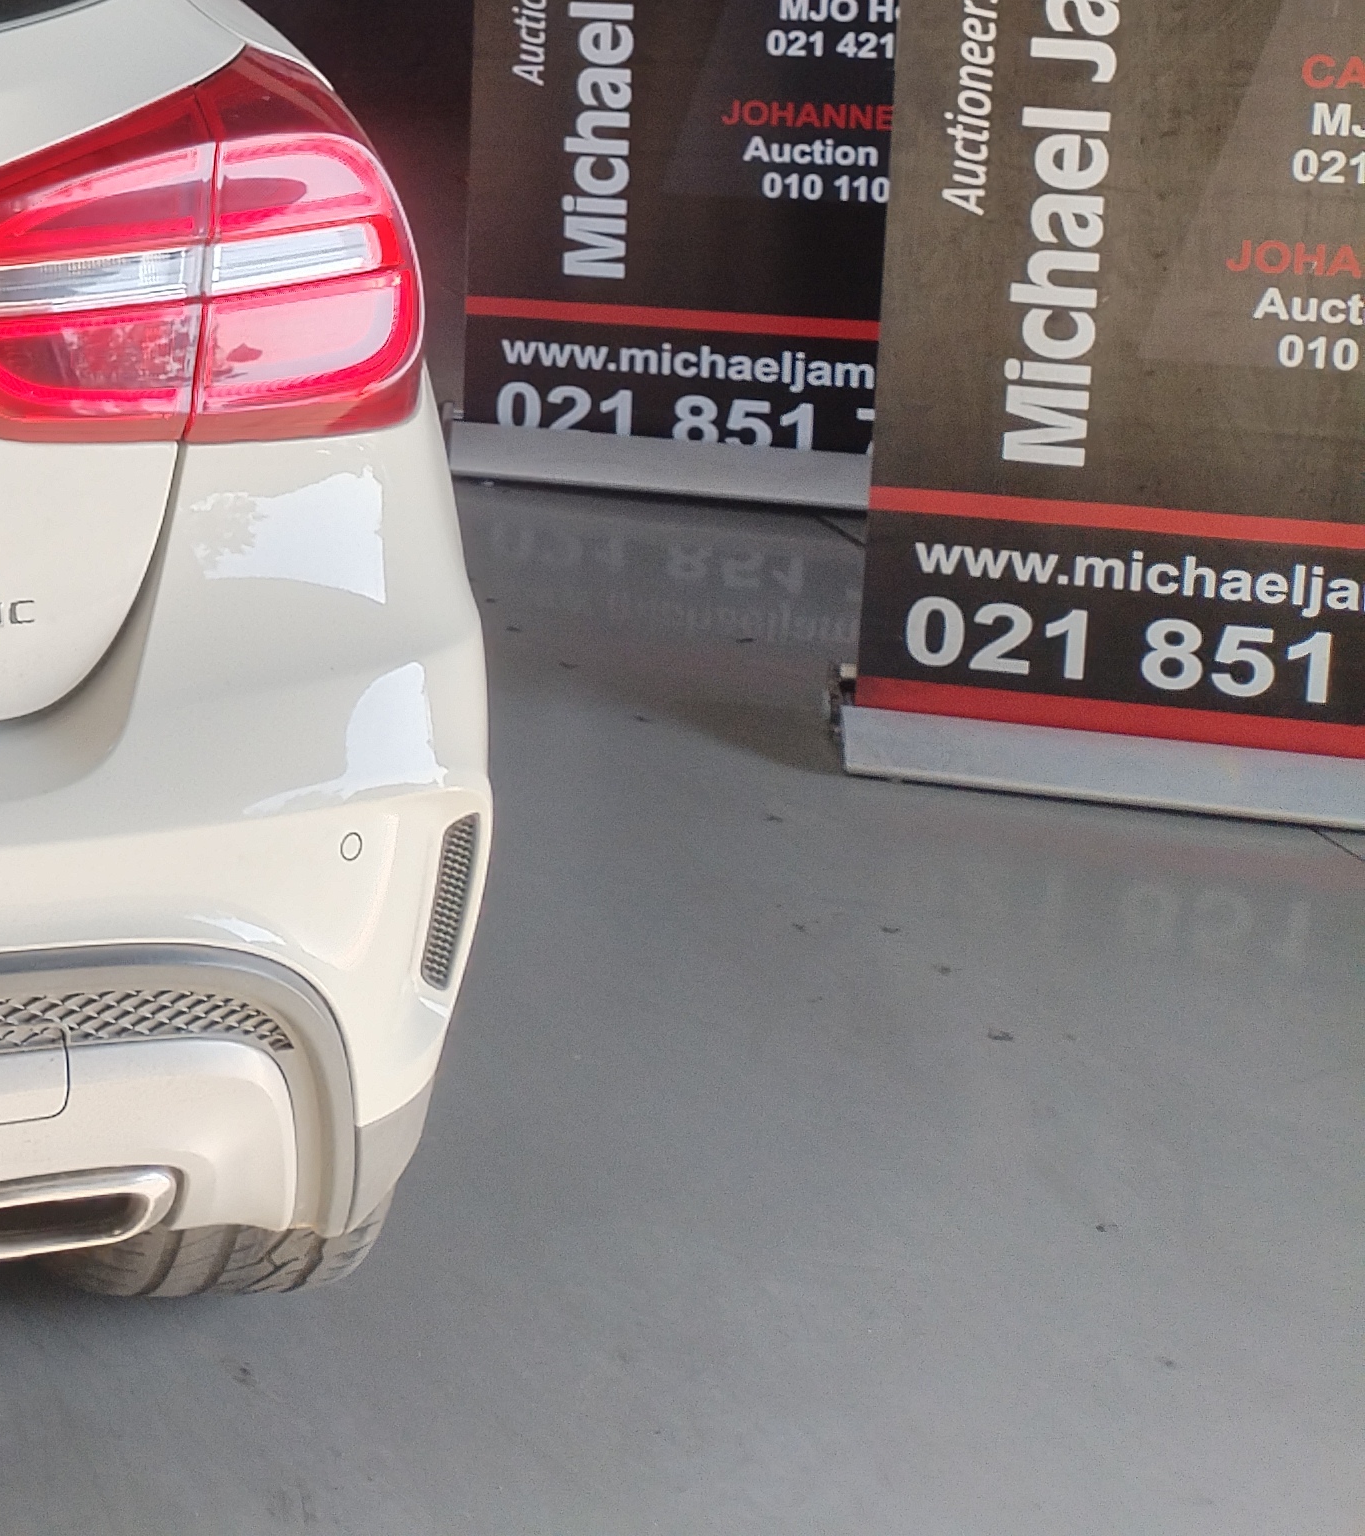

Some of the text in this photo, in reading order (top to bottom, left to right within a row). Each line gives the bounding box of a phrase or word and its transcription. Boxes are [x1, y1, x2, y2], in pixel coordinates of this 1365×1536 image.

[767, 29, 895, 59] 021 421
[562, 1, 634, 281] Michael
[743, 136, 879, 167] Auction
[762, 173, 890, 203] 010 110
[1002, 106, 1112, 467] Michael
[1278, 334, 1360, 371] 010
[495, 381, 634, 435] 021
[671, 394, 814, 451] 851
[914, 541, 1365, 618] www.michaelja
[904, 595, 1089, 681] 021
[1140, 617, 1333, 704] 851
